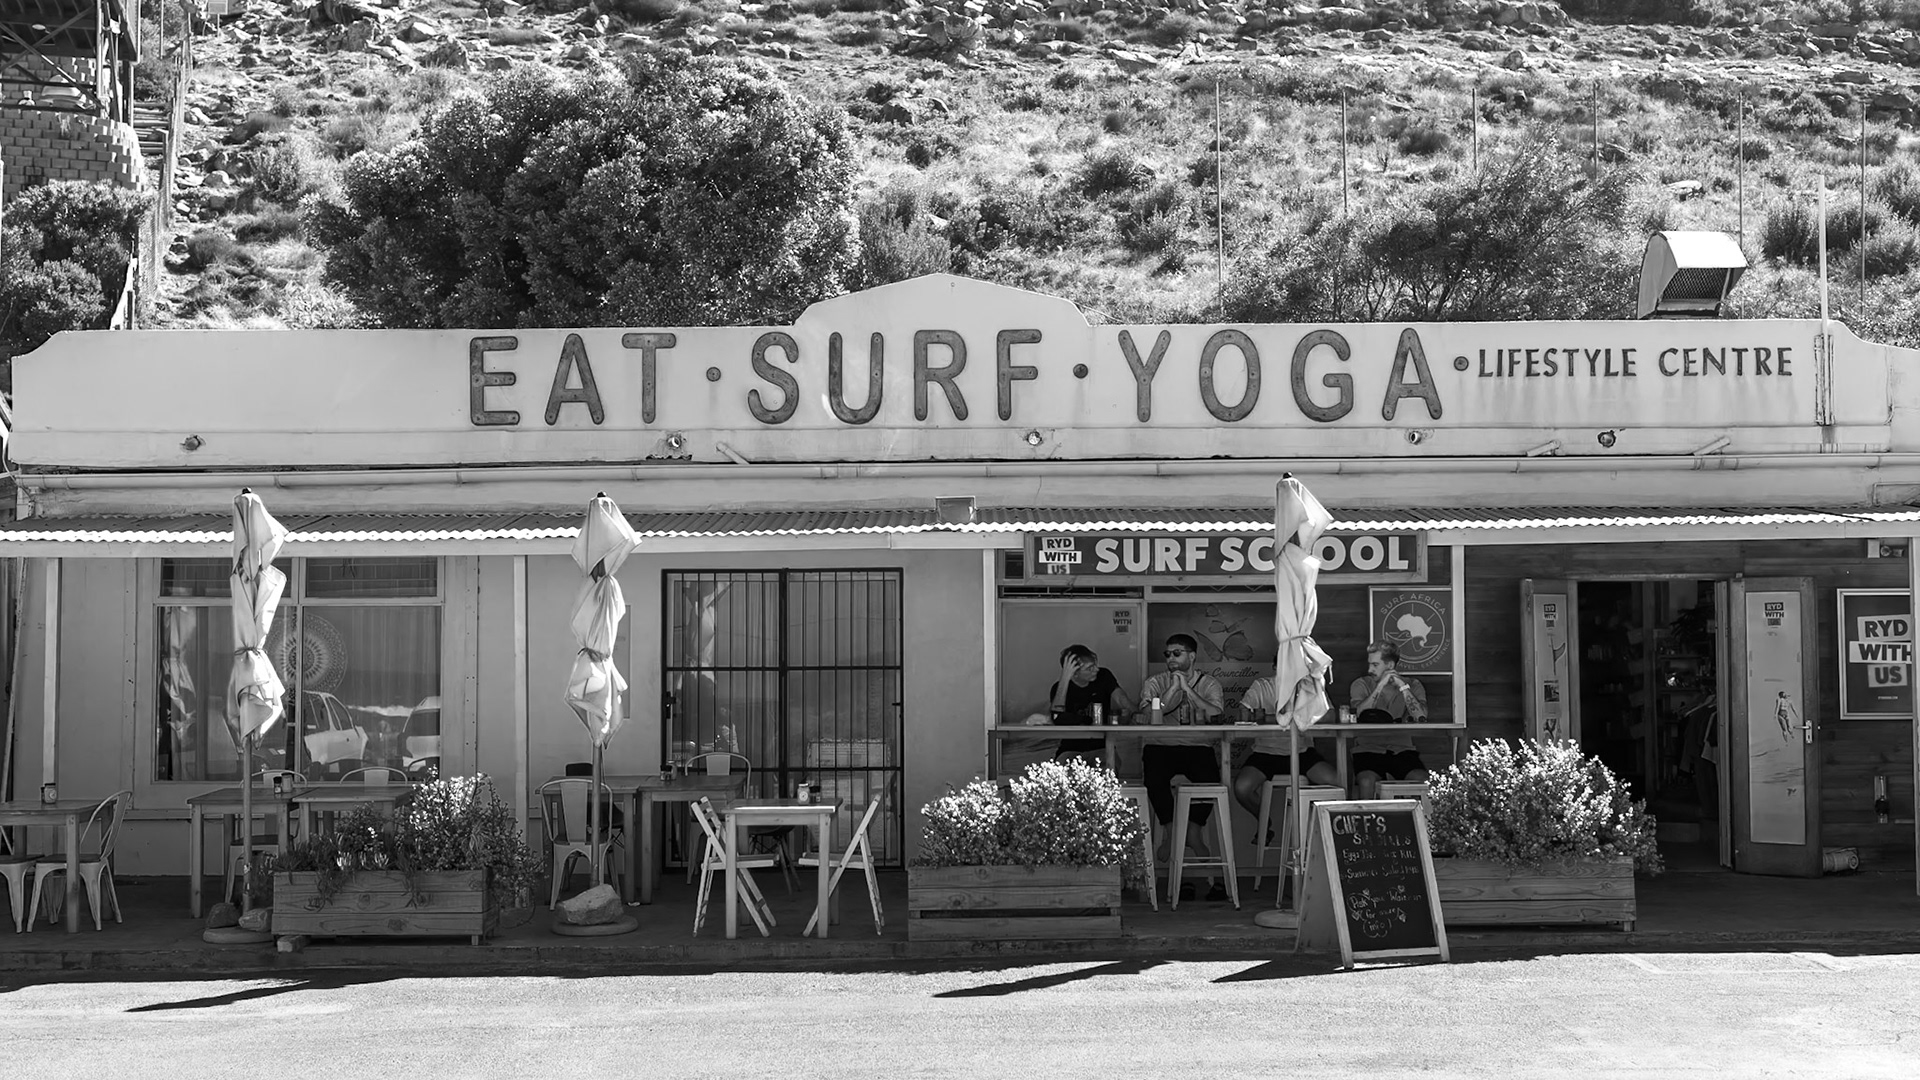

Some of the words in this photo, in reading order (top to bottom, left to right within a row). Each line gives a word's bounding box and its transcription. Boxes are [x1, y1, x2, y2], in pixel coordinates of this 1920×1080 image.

[1478, 347, 1638, 378] LIFESTYLE
[1658, 346, 1793, 377] CENTRE
[469, 332, 677, 427] EAT
[747, 329, 1043, 425] SURF
[1117, 327, 1443, 423] YOGA
[1046, 538, 1072, 549] RYD
[1044, 551, 1077, 563] WITH
[1094, 537, 1209, 573] SURF
[1219, 535, 1409, 572] SCOOL
[1051, 564, 1067, 574] US
[1380, 593, 1405, 615] SURF
[1410, 592, 1446, 615] AFRICA
[1114, 610, 1130, 618] RYD
[1864, 619, 1909, 638] RYD
[1858, 643, 1912, 661] WITH
[1211, 665, 1260, 678] Councillor
[1874, 665, 1903, 684] US
[1332, 812, 1387, 835] CHEF'S
